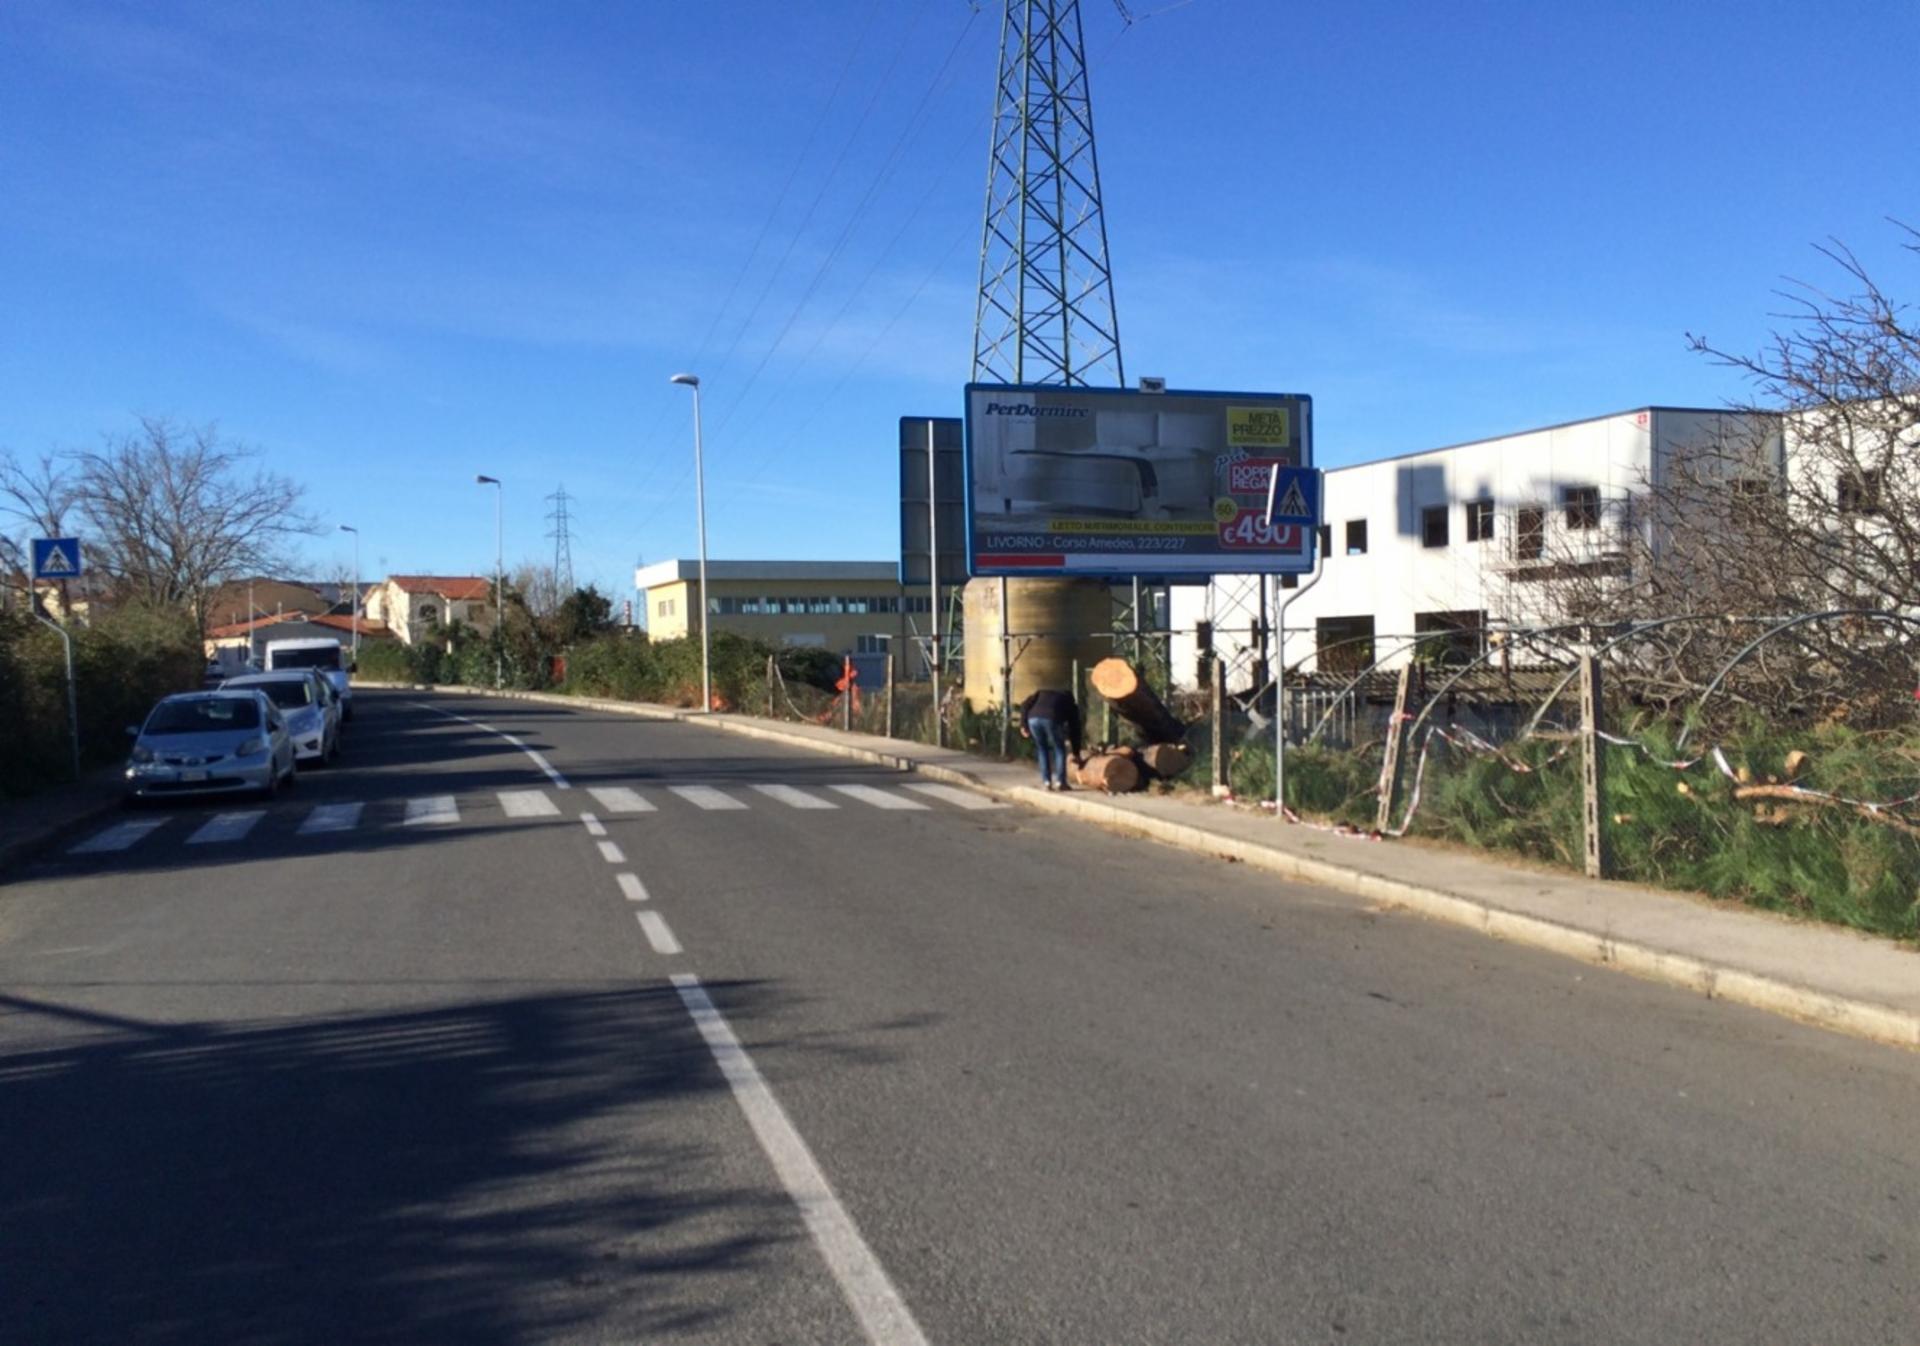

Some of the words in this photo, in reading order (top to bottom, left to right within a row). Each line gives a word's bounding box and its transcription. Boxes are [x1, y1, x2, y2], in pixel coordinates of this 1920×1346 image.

[1232, 424, 1282, 436] PREZZO
[1231, 478, 1270, 490] REGA
[987, 536, 1045, 549] LIVORNO
[1053, 536, 1087, 549] Corso
